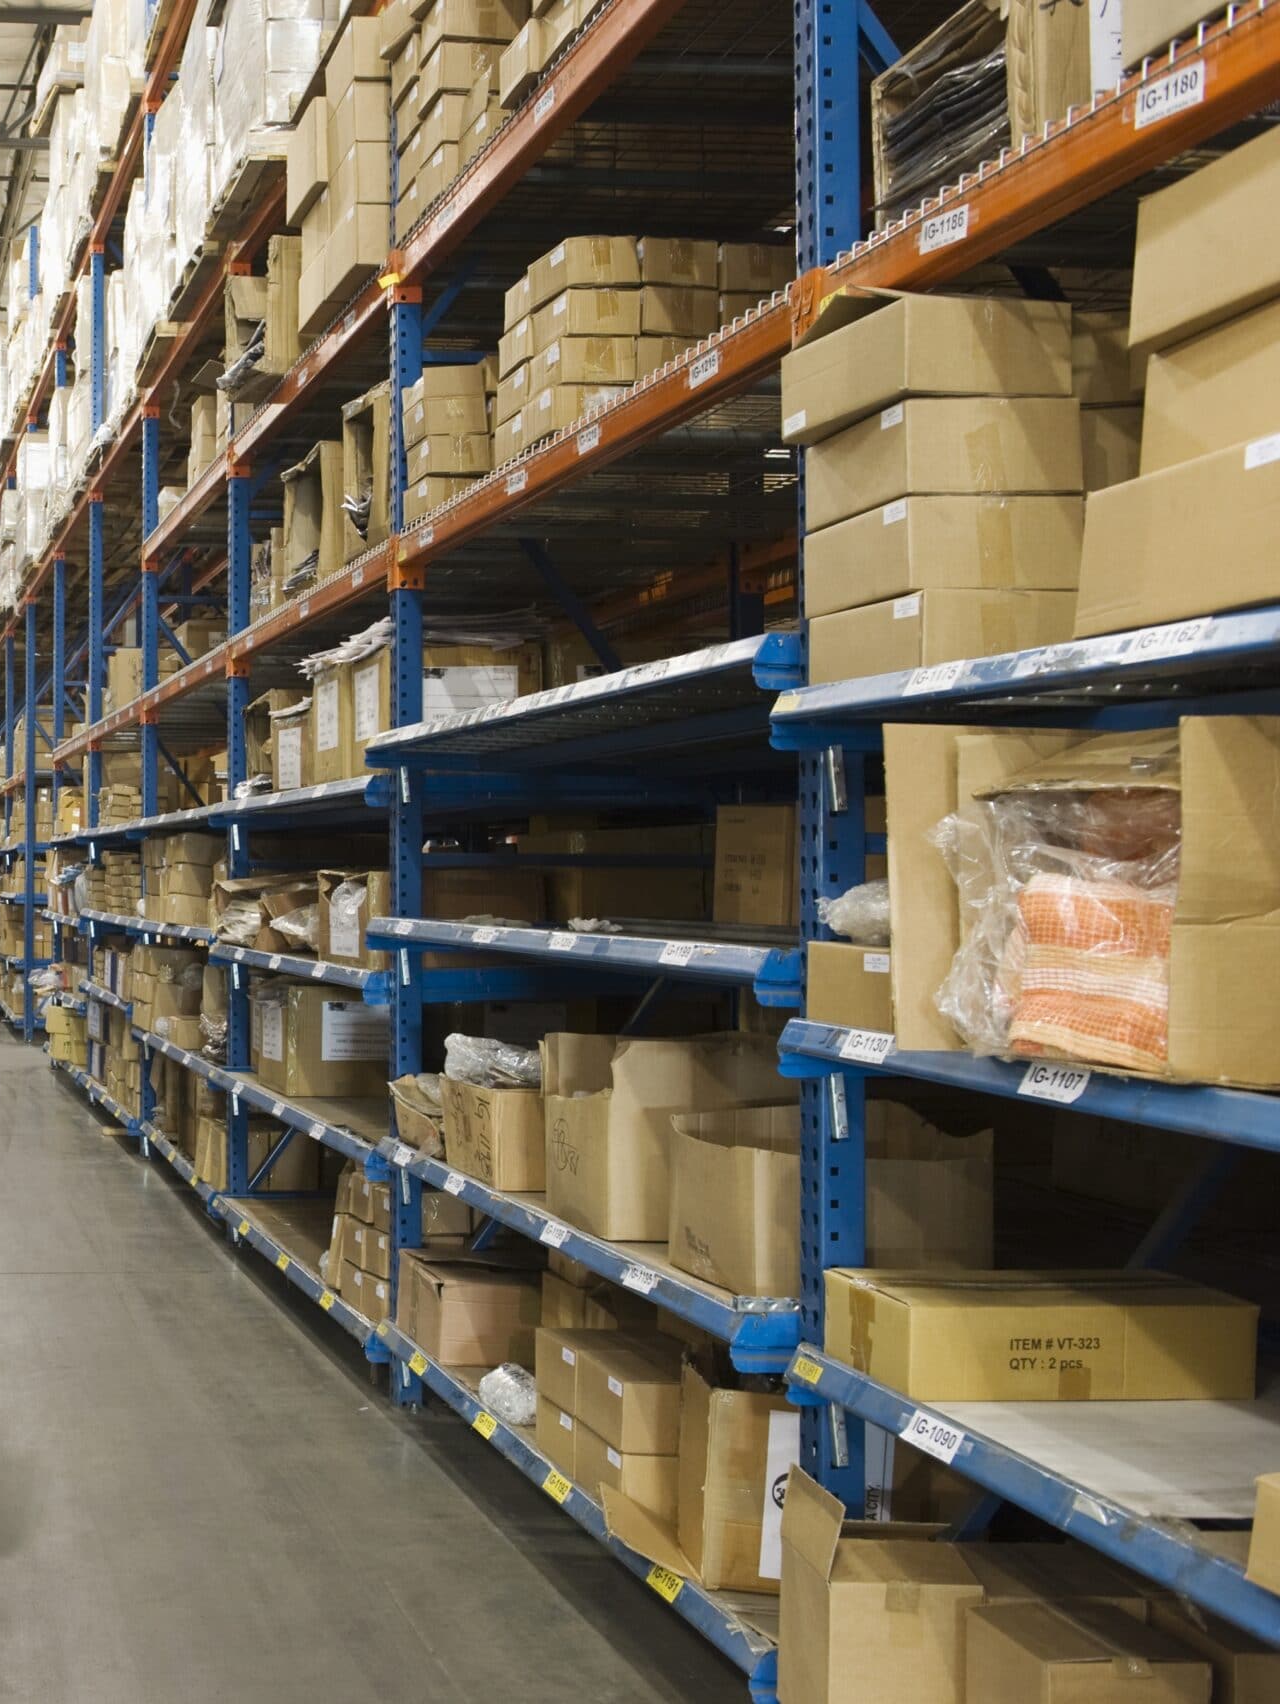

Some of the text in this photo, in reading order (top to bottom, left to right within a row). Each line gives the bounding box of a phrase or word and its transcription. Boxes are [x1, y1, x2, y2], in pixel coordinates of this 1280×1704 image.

[1140, 71, 1198, 112] IG-1180
[1135, 625, 1200, 650] IG-1162
[848, 1034, 889, 1053] IG-1130
[1029, 1067, 1084, 1090] IG-1107
[1009, 1337, 1101, 1351] ITEM # VT-323
[1008, 1357, 1037, 1371] QTY
[1048, 1357, 1056, 1370] 2
[1060, 1359, 1083, 1372] pcs
[912, 1414, 958, 1450] IG-1090
[653, 1565, 680, 1594] IG-1191
